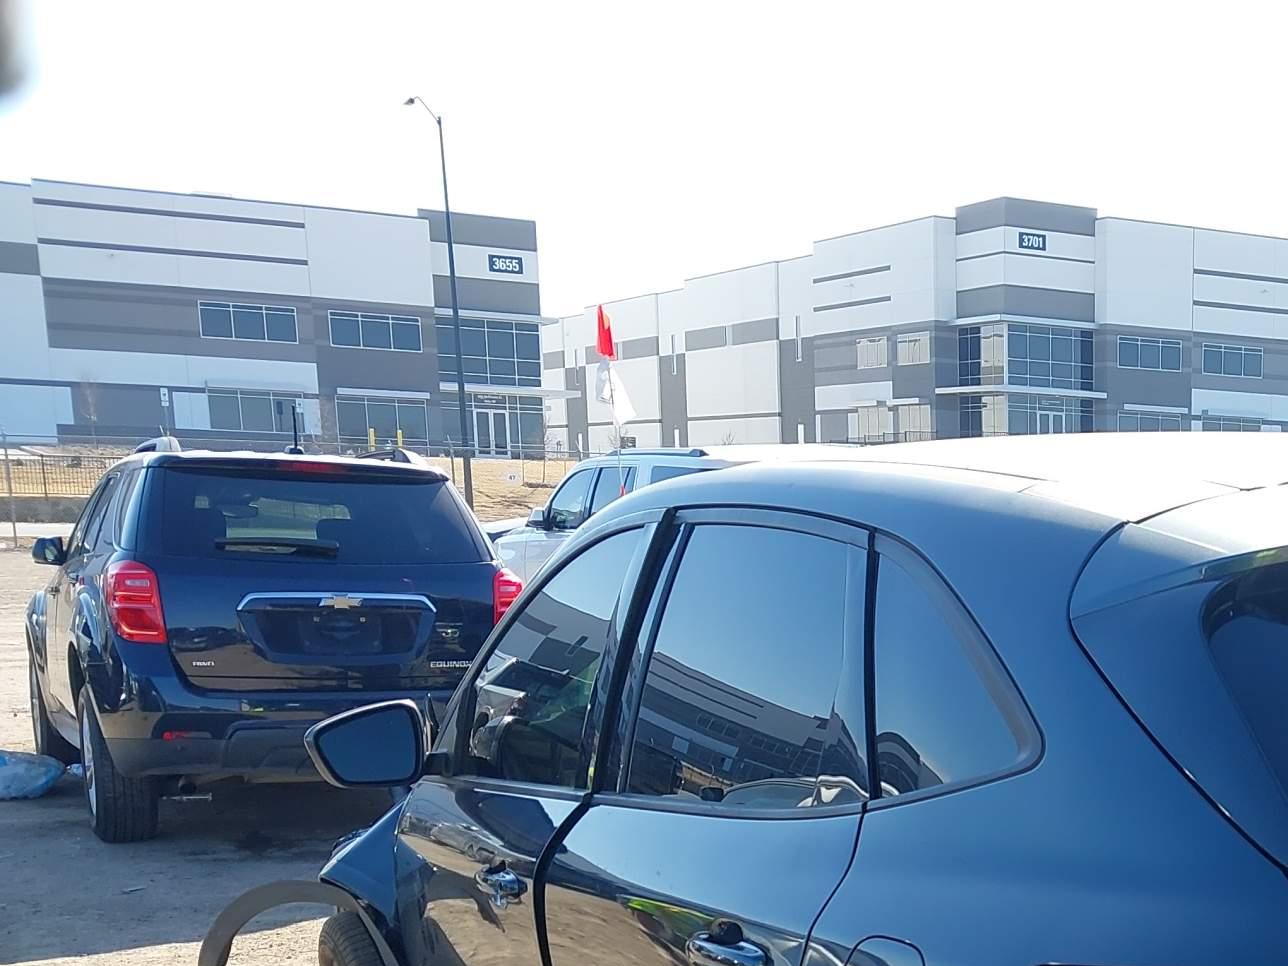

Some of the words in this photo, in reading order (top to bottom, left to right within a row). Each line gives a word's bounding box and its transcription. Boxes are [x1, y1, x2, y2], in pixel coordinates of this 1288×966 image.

[1022, 234, 1043, 248] 3701
[492, 257, 519, 271] 3655
[430, 660, 473, 668] EQUINOX
